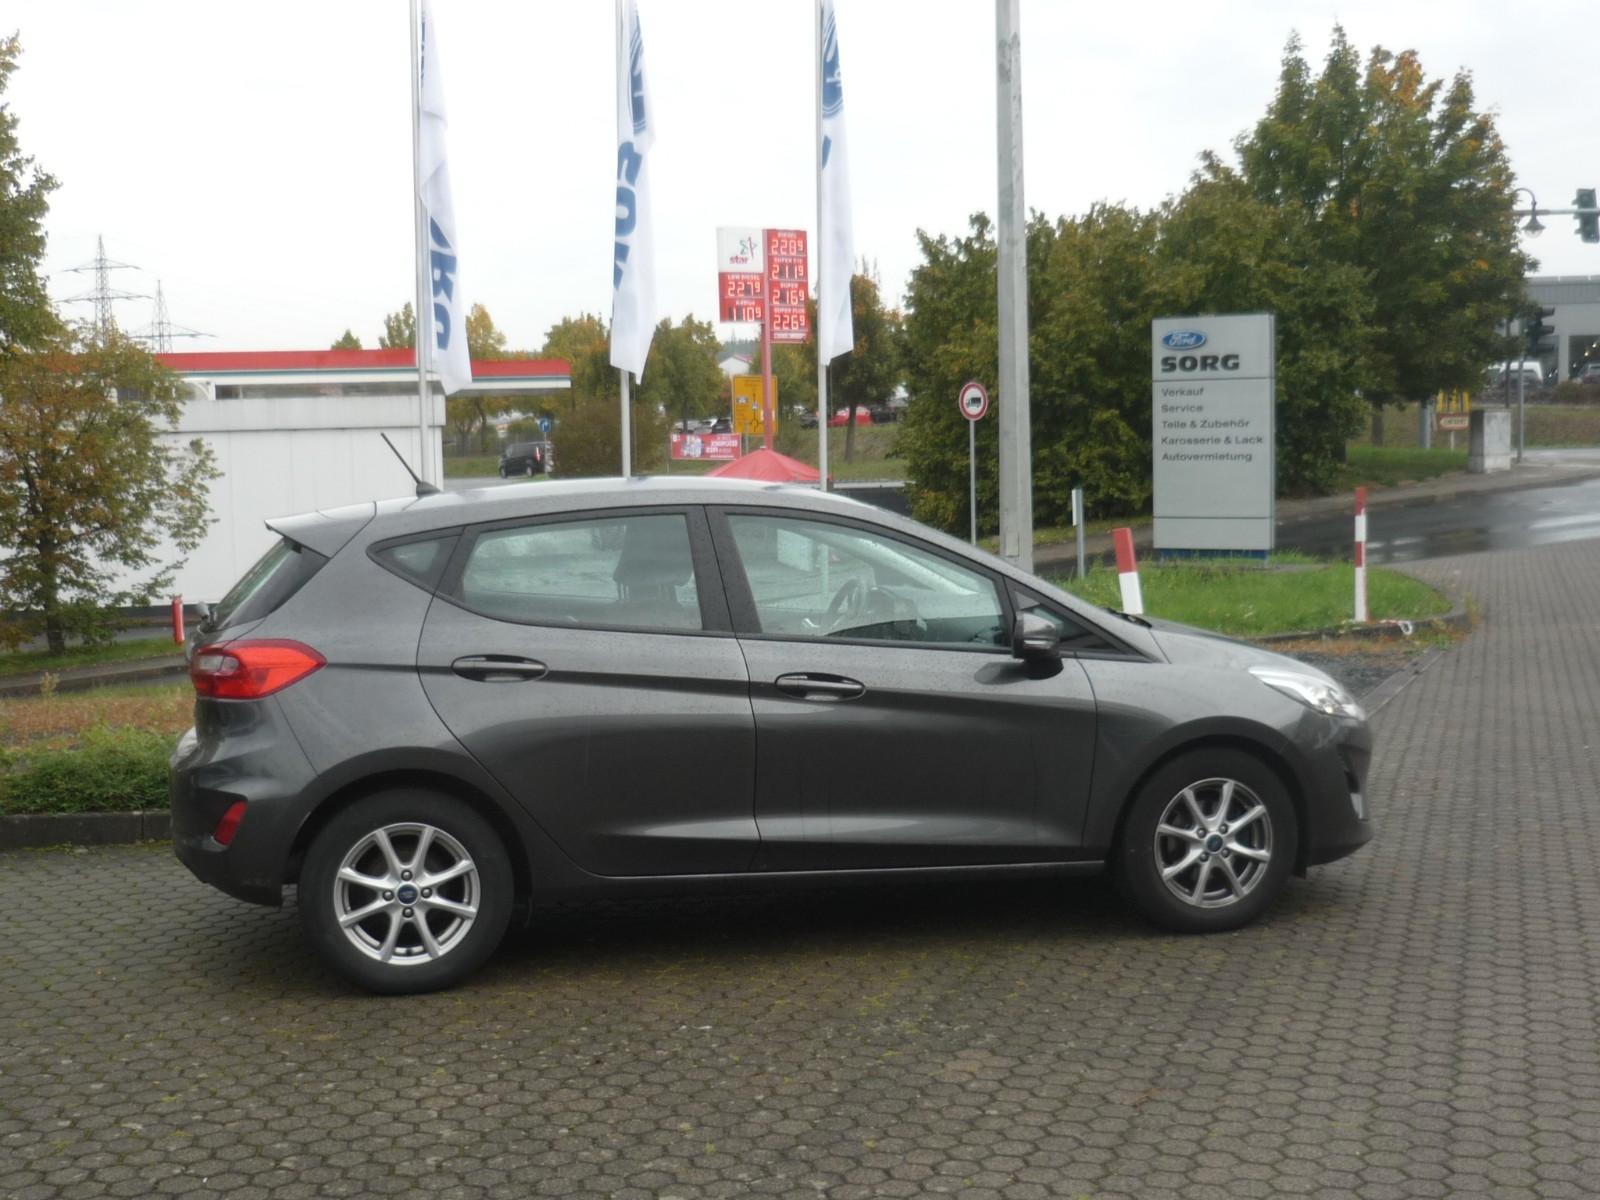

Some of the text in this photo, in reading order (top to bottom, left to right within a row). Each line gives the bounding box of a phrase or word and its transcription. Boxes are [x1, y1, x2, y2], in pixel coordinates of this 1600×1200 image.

[729, 255, 749, 265] star
[1160, 354, 1240, 373] SORG
[1161, 387, 1204, 397] Verkauf
[1161, 404, 1203, 413] Service
[1162, 418, 1250, 429] Teile & Zubehör
[1160, 435, 1263, 446] Karosserie & Lack
[1162, 452, 1253, 463] Autovermietung
